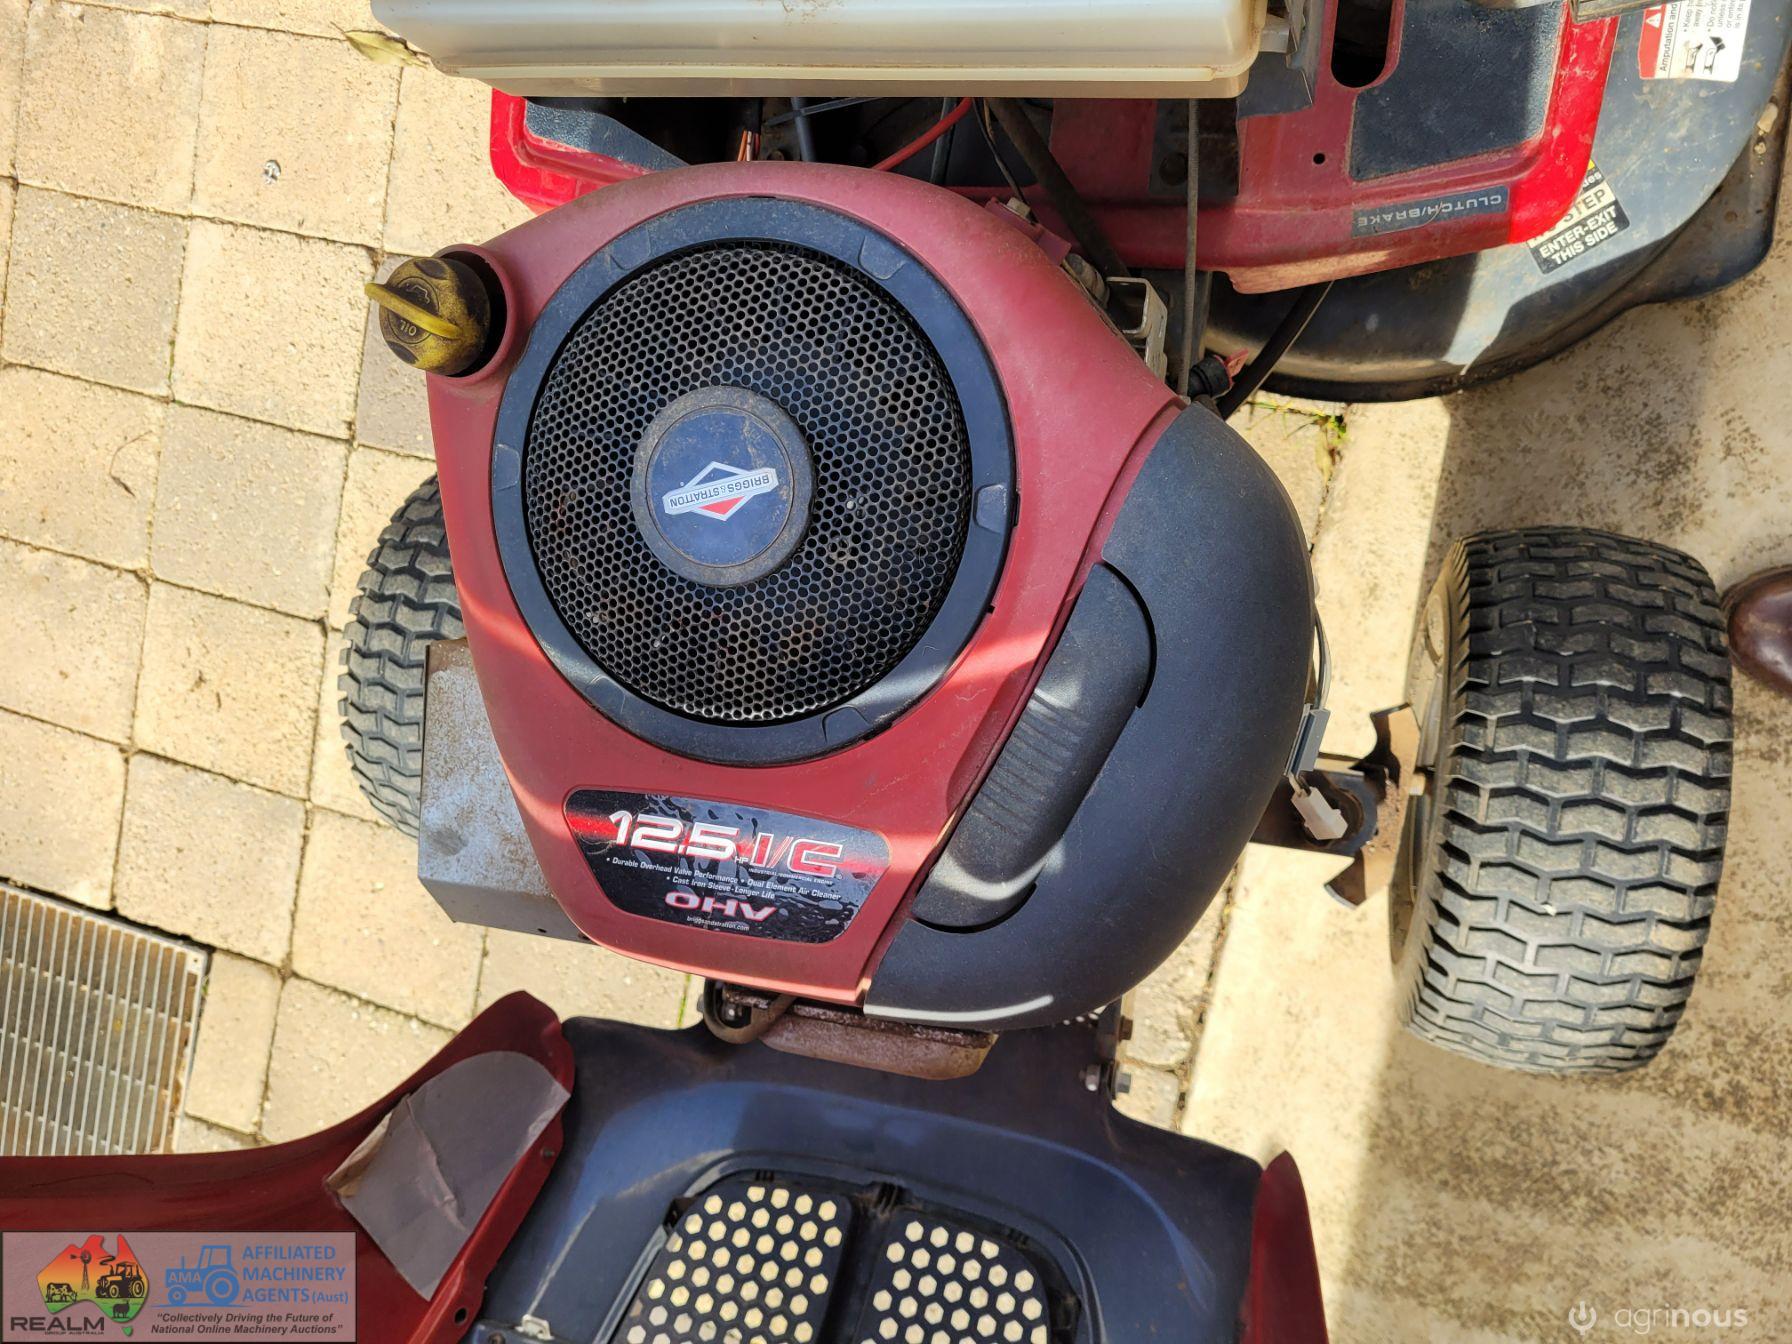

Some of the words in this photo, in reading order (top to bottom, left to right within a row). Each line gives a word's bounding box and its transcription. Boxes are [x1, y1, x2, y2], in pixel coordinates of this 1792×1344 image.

[1683, 9, 1693, 27] Keep
[1707, 16, 1715, 27] Do
[1660, 23, 1674, 71] Amputation
[1357, 195, 1502, 227] CLUTCH/BRAKE
[1539, 205, 1617, 258] ENTER-EXIT
[1552, 242, 1585, 264] THIS
[1585, 221, 1618, 246] SIDE
[400, 319, 417, 336] OIL
[728, 474, 770, 493] BRIGGS
[669, 490, 720, 508] STRATTON
[608, 810, 740, 861] 12.5
[734, 856, 749, 864] HP
[612, 857, 639, 868] Durable
[640, 861, 673, 873] Overhead
[674, 867, 692, 876] Valve
[694, 870, 738, 884] Performance
[747, 879, 765, 888] Dual
[766, 880, 797, 893] Element
[798, 887, 810, 897] Air
[811, 890, 841, 900] Cleaner
[672, 876, 690, 885] Cast
[692, 879, 706, 888] Iron
[761, 891, 775, 900] Life
[664, 891, 778, 922] OHV
[686, 915, 750, 931] briggsandstratton.com
